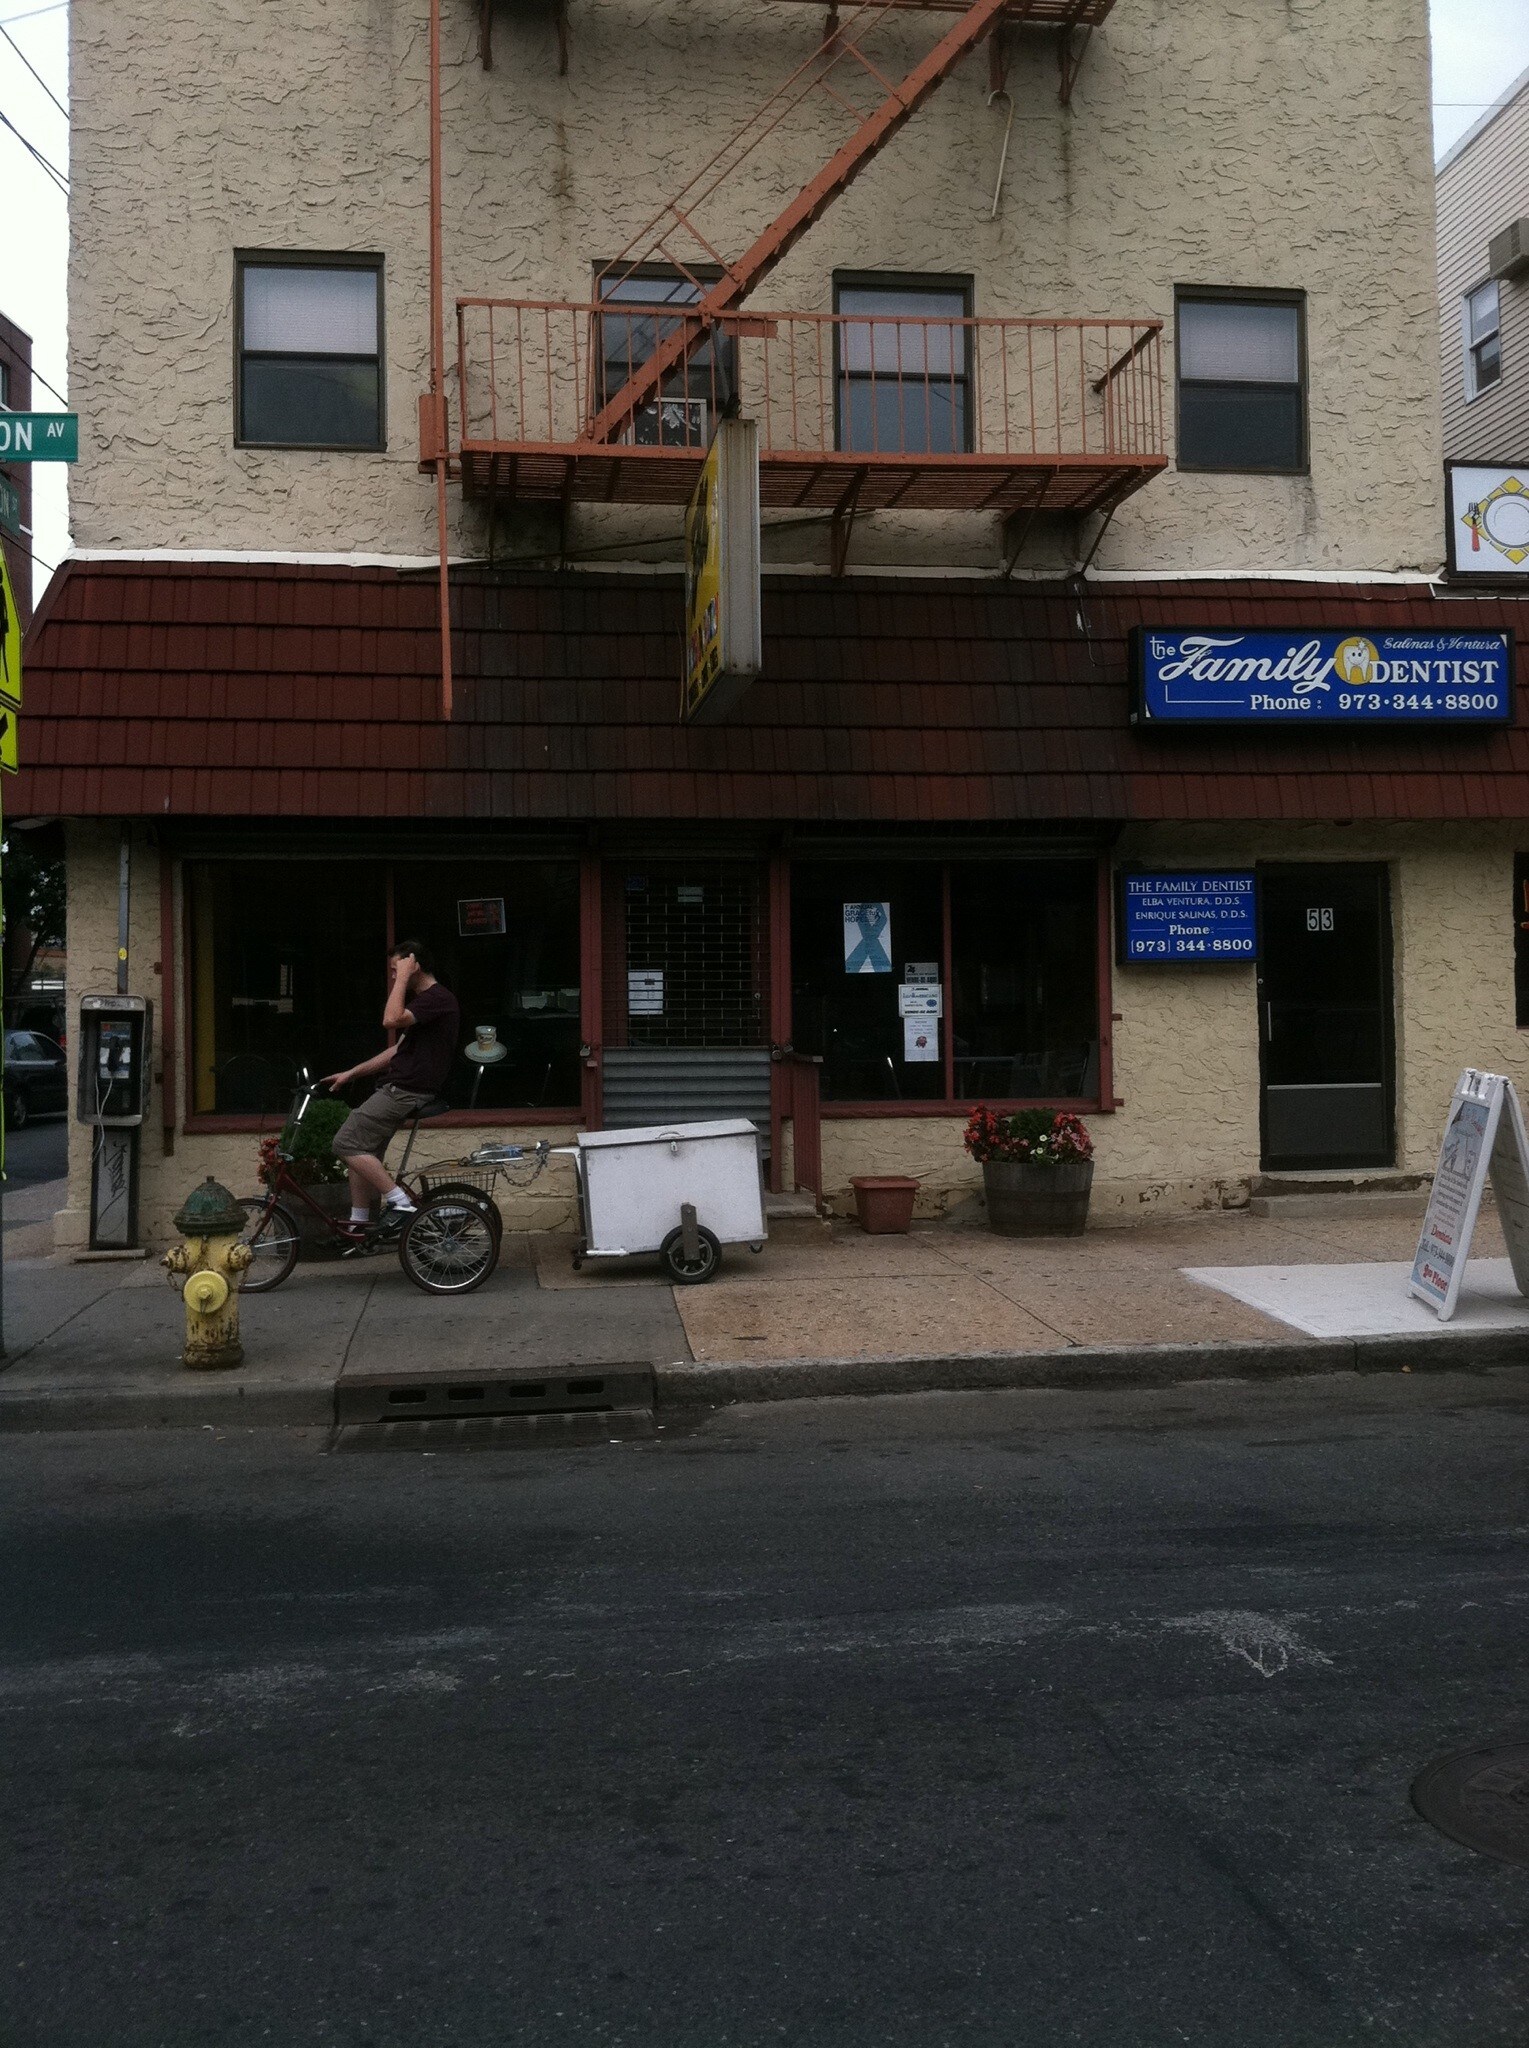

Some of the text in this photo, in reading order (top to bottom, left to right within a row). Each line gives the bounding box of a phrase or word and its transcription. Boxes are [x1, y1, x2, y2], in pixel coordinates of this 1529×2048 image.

[47, 422, 65, 438] AV
[1383, 637, 1434, 650] Salinas
[1447, 637, 1501, 650] Ventura
[1150, 636, 1499, 694] the Family DENTIST
[1128, 880, 1252, 893] THE FAMILY DENTIST
[1142, 898, 1164, 906] ELBA
[1135, 911, 1176, 921] ENRIQUE
[1308, 909, 1332, 929] 53
[1131, 939, 1171, 953] (973)
